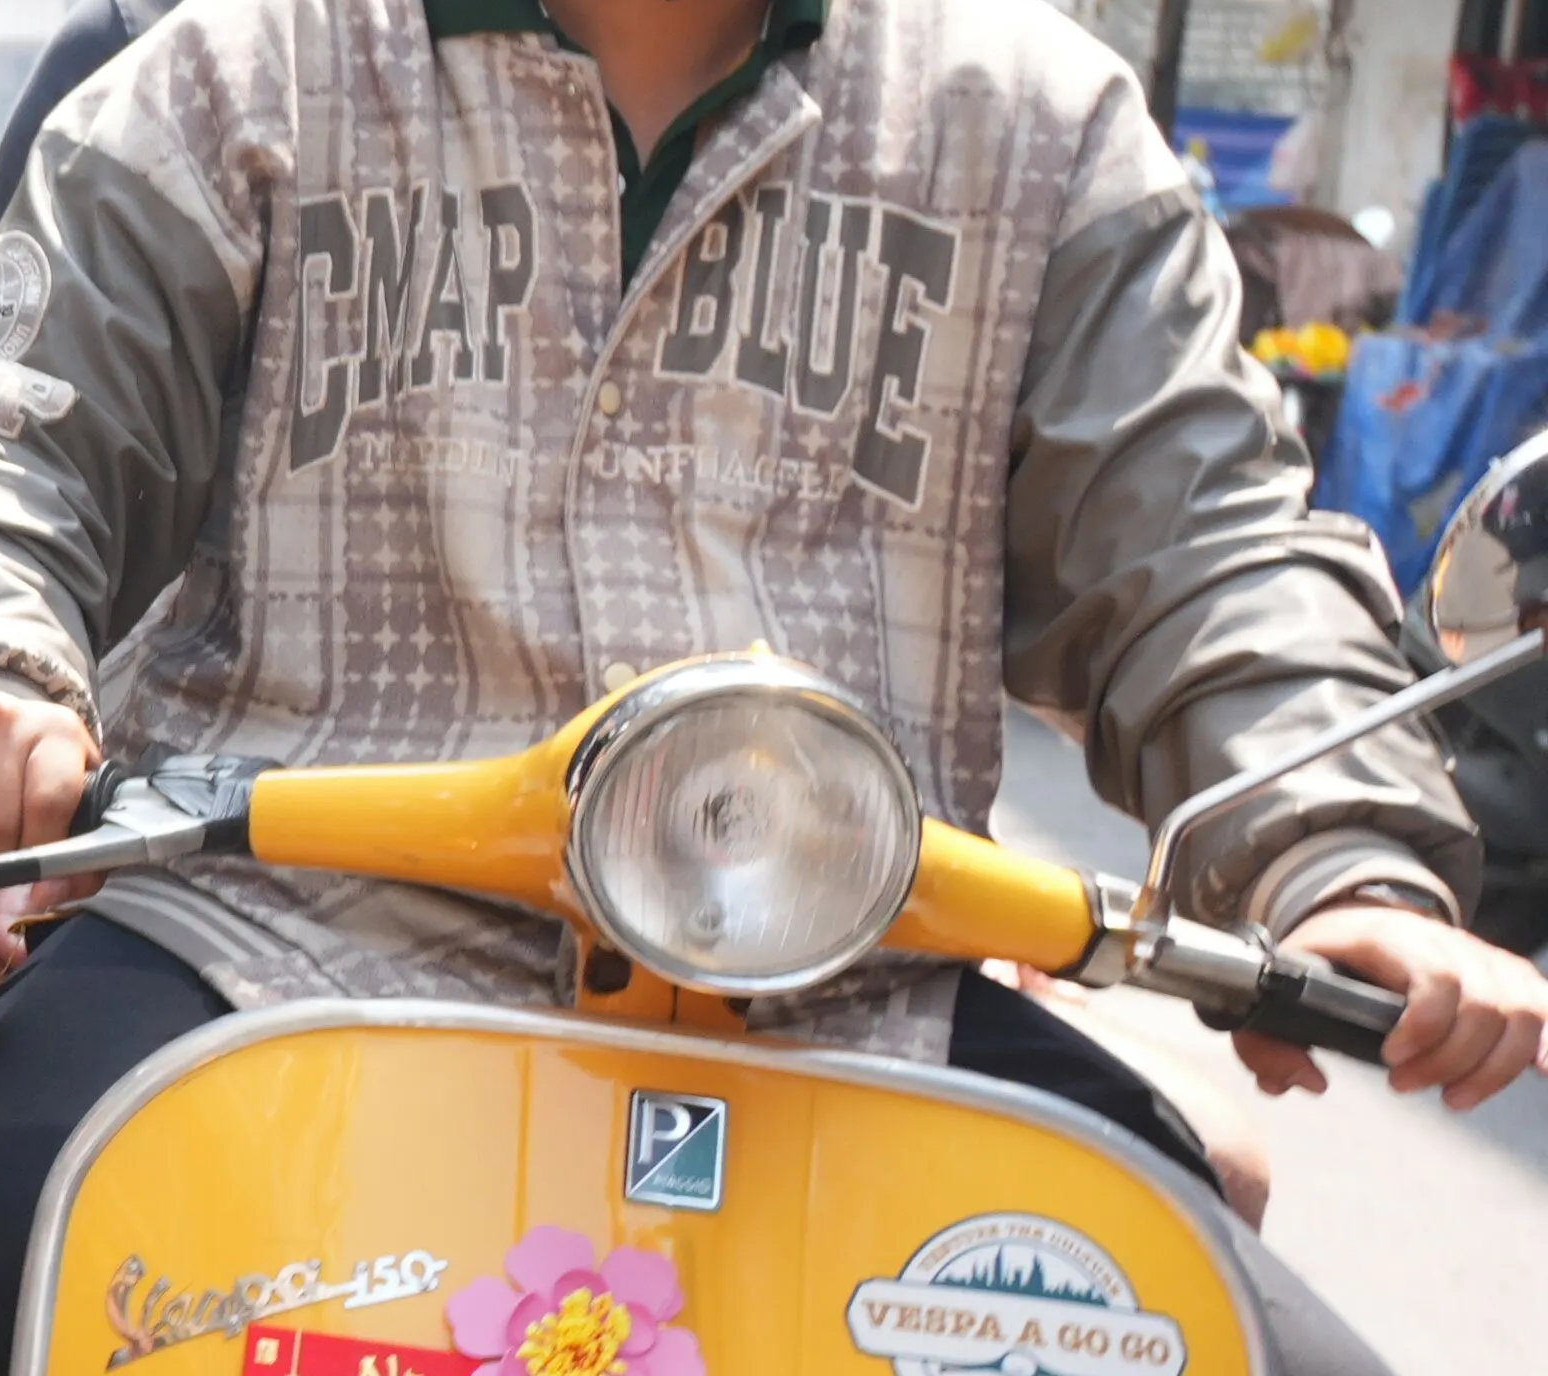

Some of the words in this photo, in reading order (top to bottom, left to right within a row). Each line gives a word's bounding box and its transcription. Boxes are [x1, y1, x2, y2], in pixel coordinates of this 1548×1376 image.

[638, 1099, 693, 1164] P
[105, 1253, 322, 1372] Vespa
[863, 1299, 1006, 1344] VESPA
[1016, 1317, 1048, 1349] A
[1058, 1323, 1110, 1358] GO
[1119, 1330, 1171, 1366] GO
